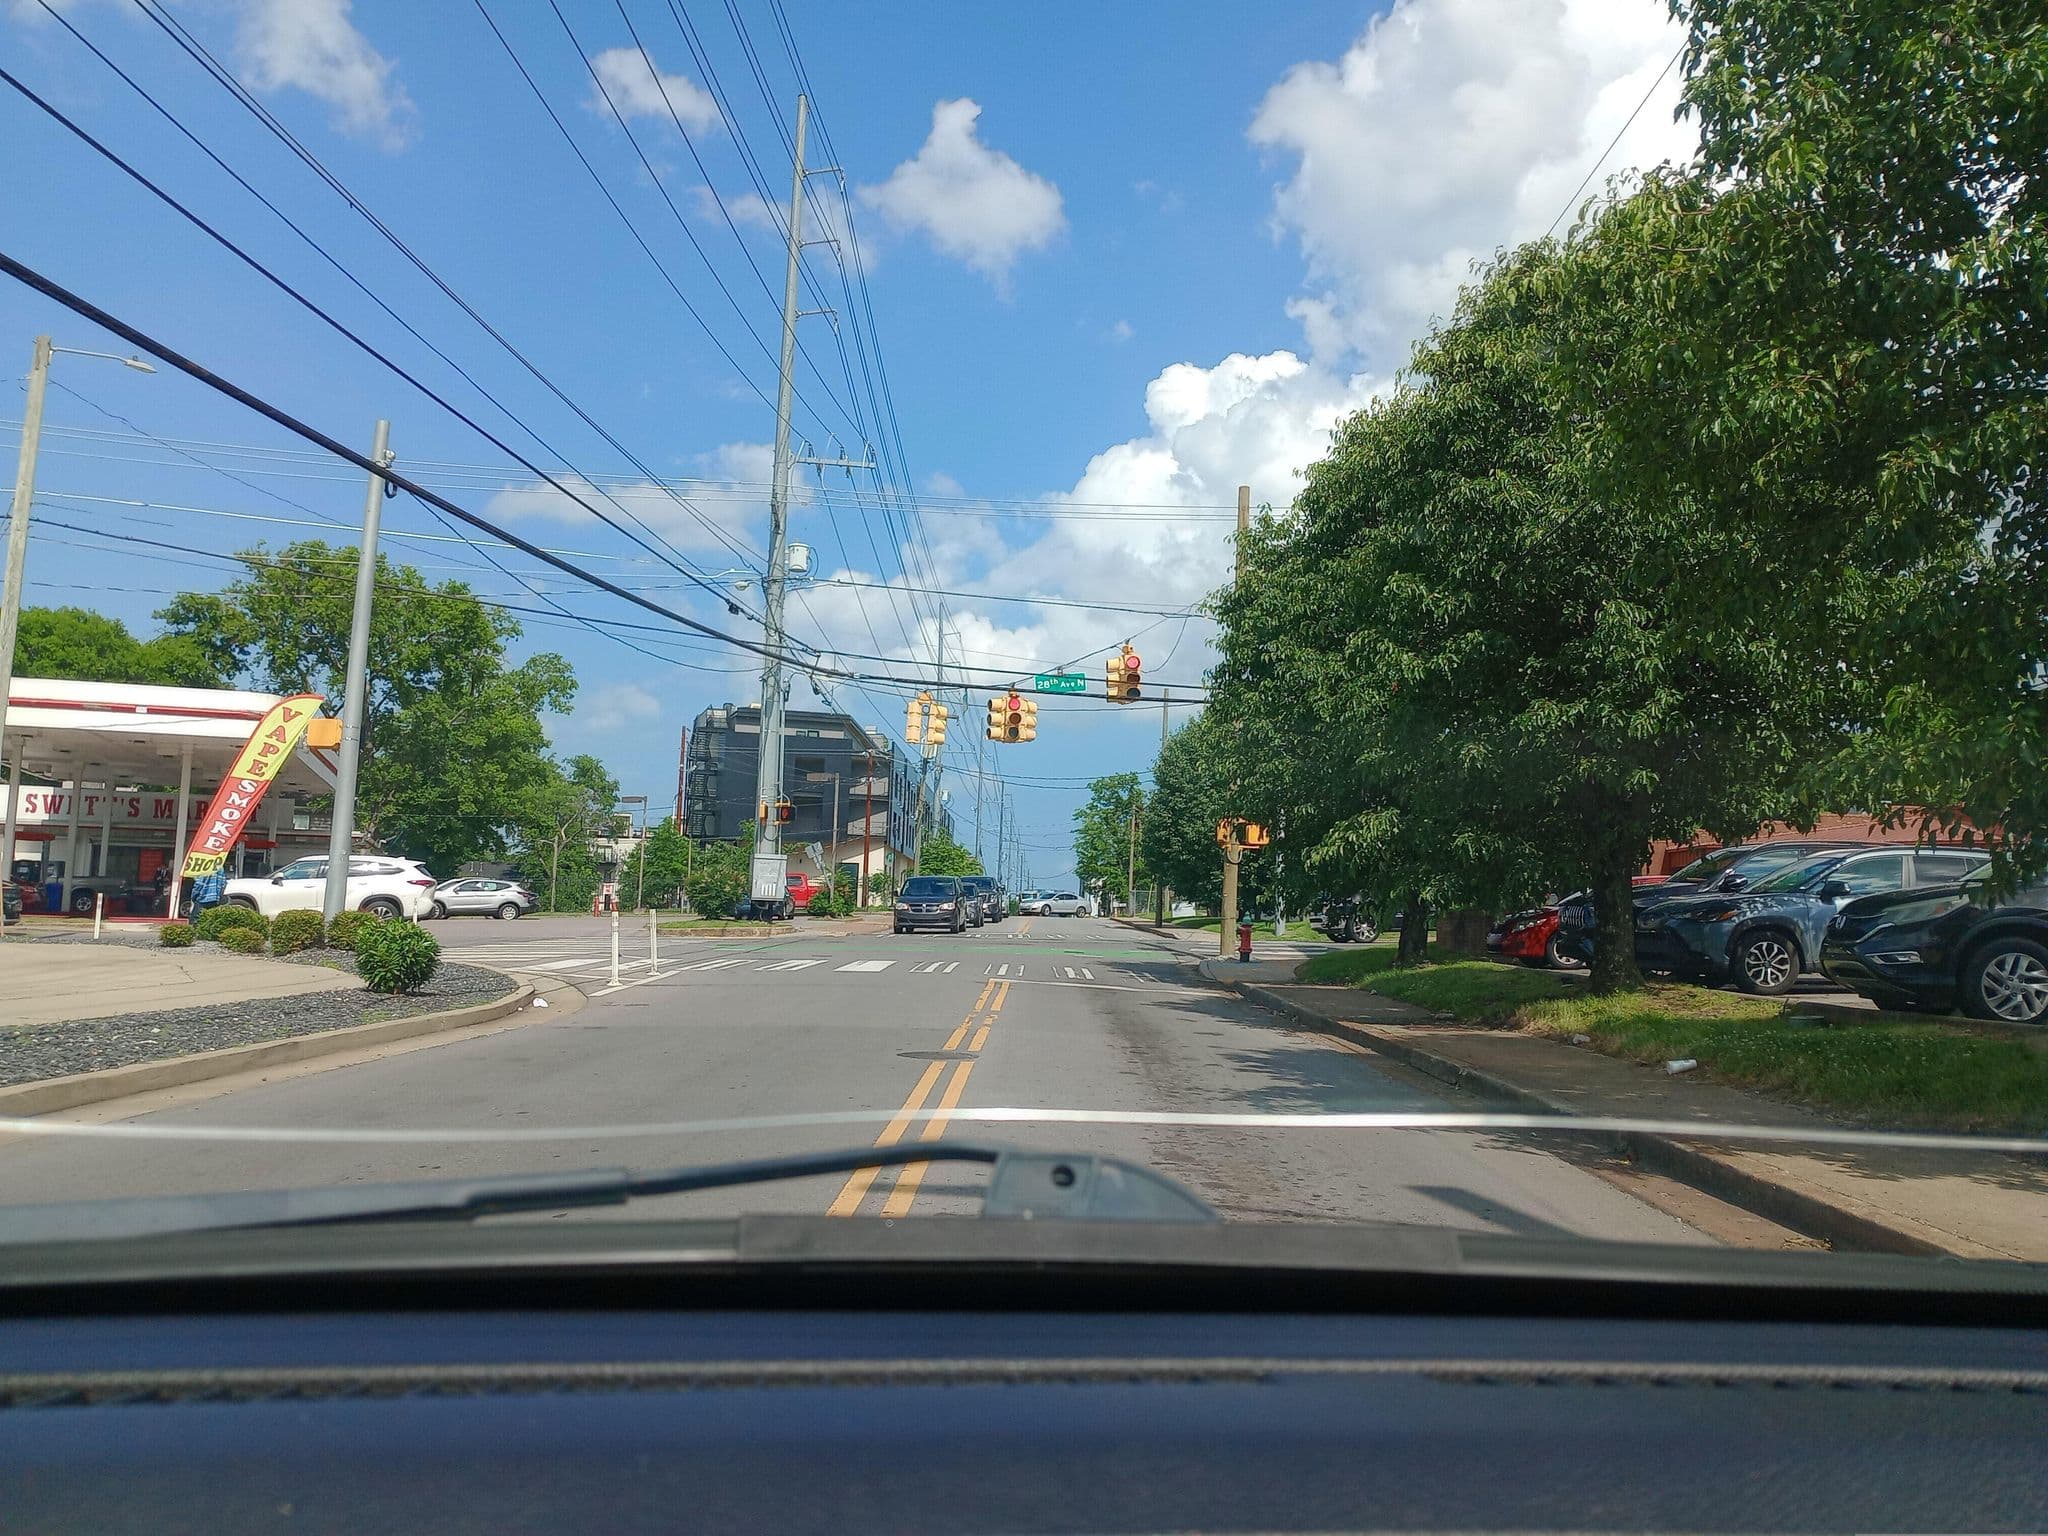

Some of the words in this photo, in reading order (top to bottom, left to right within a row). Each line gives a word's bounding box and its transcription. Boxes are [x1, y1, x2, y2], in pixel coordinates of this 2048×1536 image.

[1037, 679, 1059, 689] 28th
[1077, 679, 1084, 687] N
[246, 706, 303, 778] VAPE
[203, 779, 259, 851] SMOKE
[184, 856, 223, 873] SHOP
